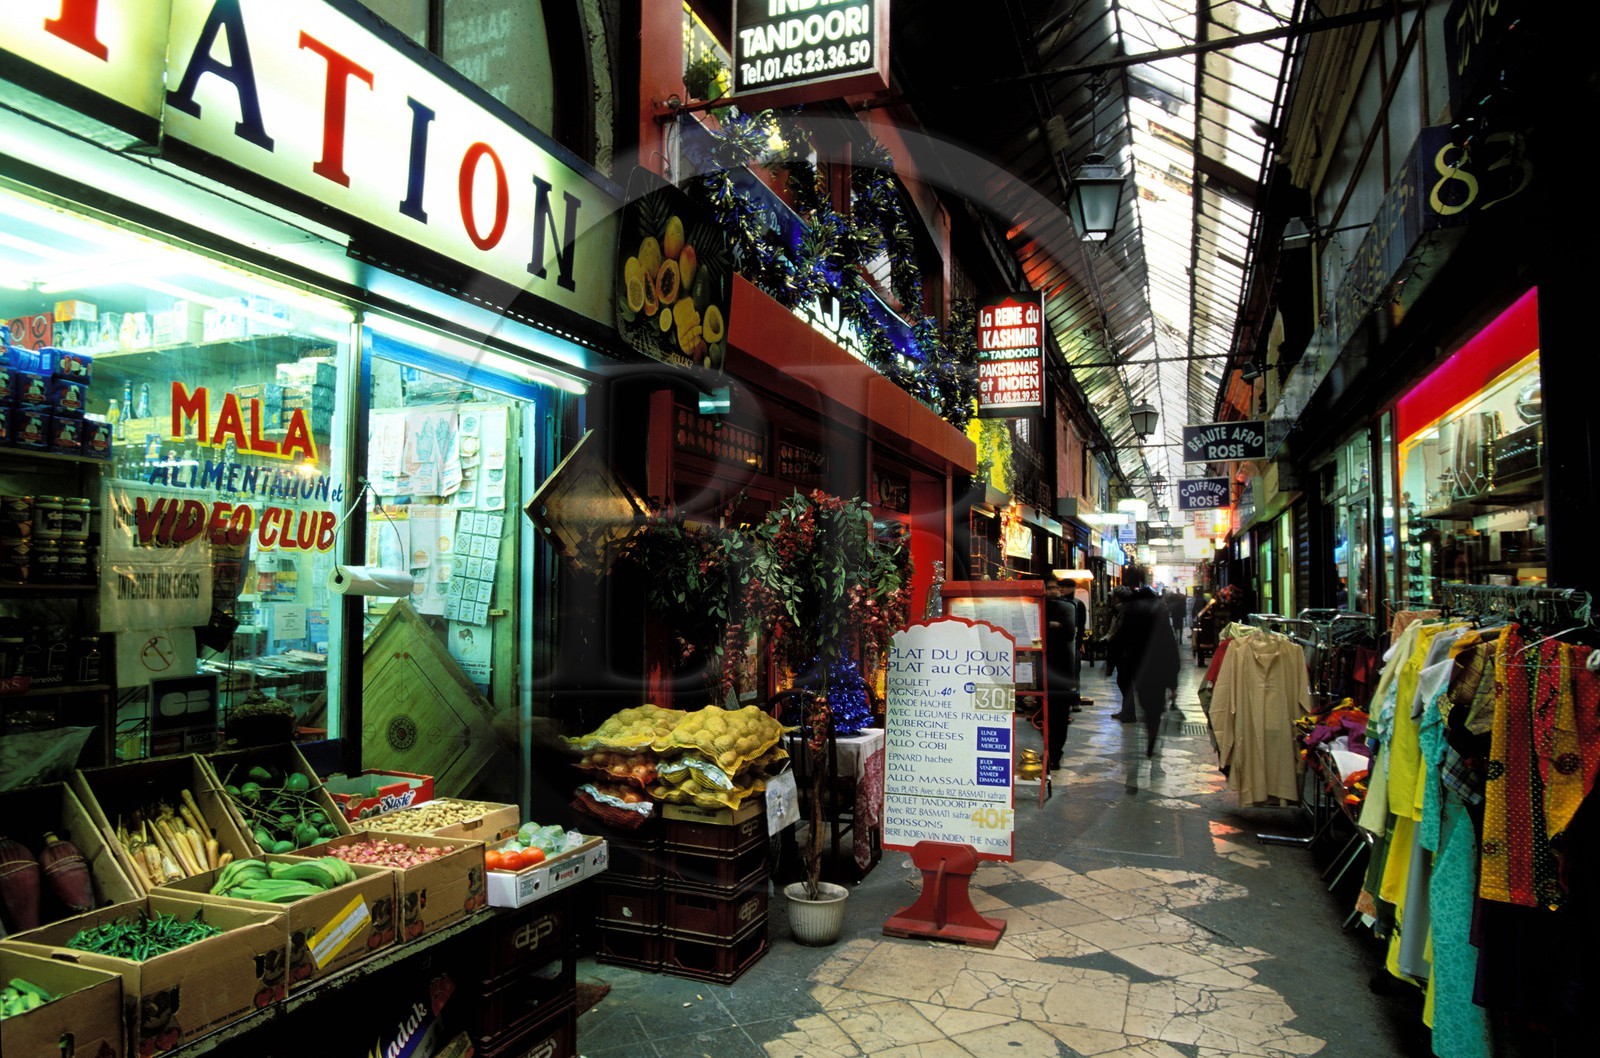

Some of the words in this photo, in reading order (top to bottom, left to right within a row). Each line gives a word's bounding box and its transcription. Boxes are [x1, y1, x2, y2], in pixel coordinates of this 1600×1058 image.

[739, 4, 869, 58] TANDOORI
[980, 310, 992, 328] La
[995, 306, 1023, 327] REINE
[1026, 306, 1040, 323] du
[983, 327, 1037, 349] KASHMIR
[989, 348, 1039, 360] TANDOORI
[980, 361, 1039, 377] PAKISTANAIS
[981, 378, 994, 391] et
[998, 375, 1040, 391] INDIEN
[171, 381, 319, 463] MALA
[1187, 426, 1227, 453] BEAUTE
[1231, 427, 1263, 447] AFRO
[1208, 444, 1244, 459] ROSE
[331, 482, 344, 504] et
[1181, 481, 1227, 497] COIFFURE
[1189, 495, 1220, 507] ROSE
[136, 497, 255, 548] VIDEO
[257, 506, 338, 551] CLUB
[888, 648, 925, 659] PLAT
[931, 649, 958, 660] DU
[965, 650, 1009, 663] JOUR
[887, 661, 925, 673] PLAT
[931, 665, 950, 674] au
[954, 664, 1011, 677] CHOIX
[888, 677, 931, 687] POULET
[888, 688, 937, 698] AGNEAU
[888, 698, 918, 707] VIANDE
[920, 699, 952, 709] HACHEE
[888, 708, 911, 717] AVEC
[914, 709, 958, 720] LEGUMES
[961, 712, 1007, 723] FRAICHES
[887, 718, 950, 729] AUBERGINE
[886, 728, 912, 738] POIS
[915, 730, 965, 741] CHEESES
[887, 739, 915, 748] ALLO
[918, 741, 947, 750] GOBI
[888, 752, 923, 762] EPINARD
[924, 755, 953, 764] hachee
[888, 763, 916, 772] DALL
[887, 773, 915, 782] ALLO
[920, 775, 976, 786] MASSALA
[886, 784, 899, 792] Tous
[901, 786, 919, 794] PLATS
[921, 787, 935, 796] Avec
[936, 788, 945, 796] du
[946, 788, 956, 797] RIZ
[958, 790, 986, 798] BASMATI
[987, 791, 1007, 800] safran
[886, 795, 918, 805] POULET
[921, 797, 966, 808] TANDOORI
[887, 806, 903, 814] Avec
[905, 807, 916, 815] RIZ
[919, 808, 950, 818] BASMATI
[952, 811, 971, 820] safra
[971, 808, 1014, 830] 40F
[886, 816, 943, 829] BOISSONS
[885, 827, 901, 836] BIERE
[904, 829, 926, 839] INDIEN
[928, 831, 940, 840] VIN
[942, 833, 965, 843] INDIEN
[969, 835, 982, 845] THE
[985, 837, 1009, 847] INDIEN
